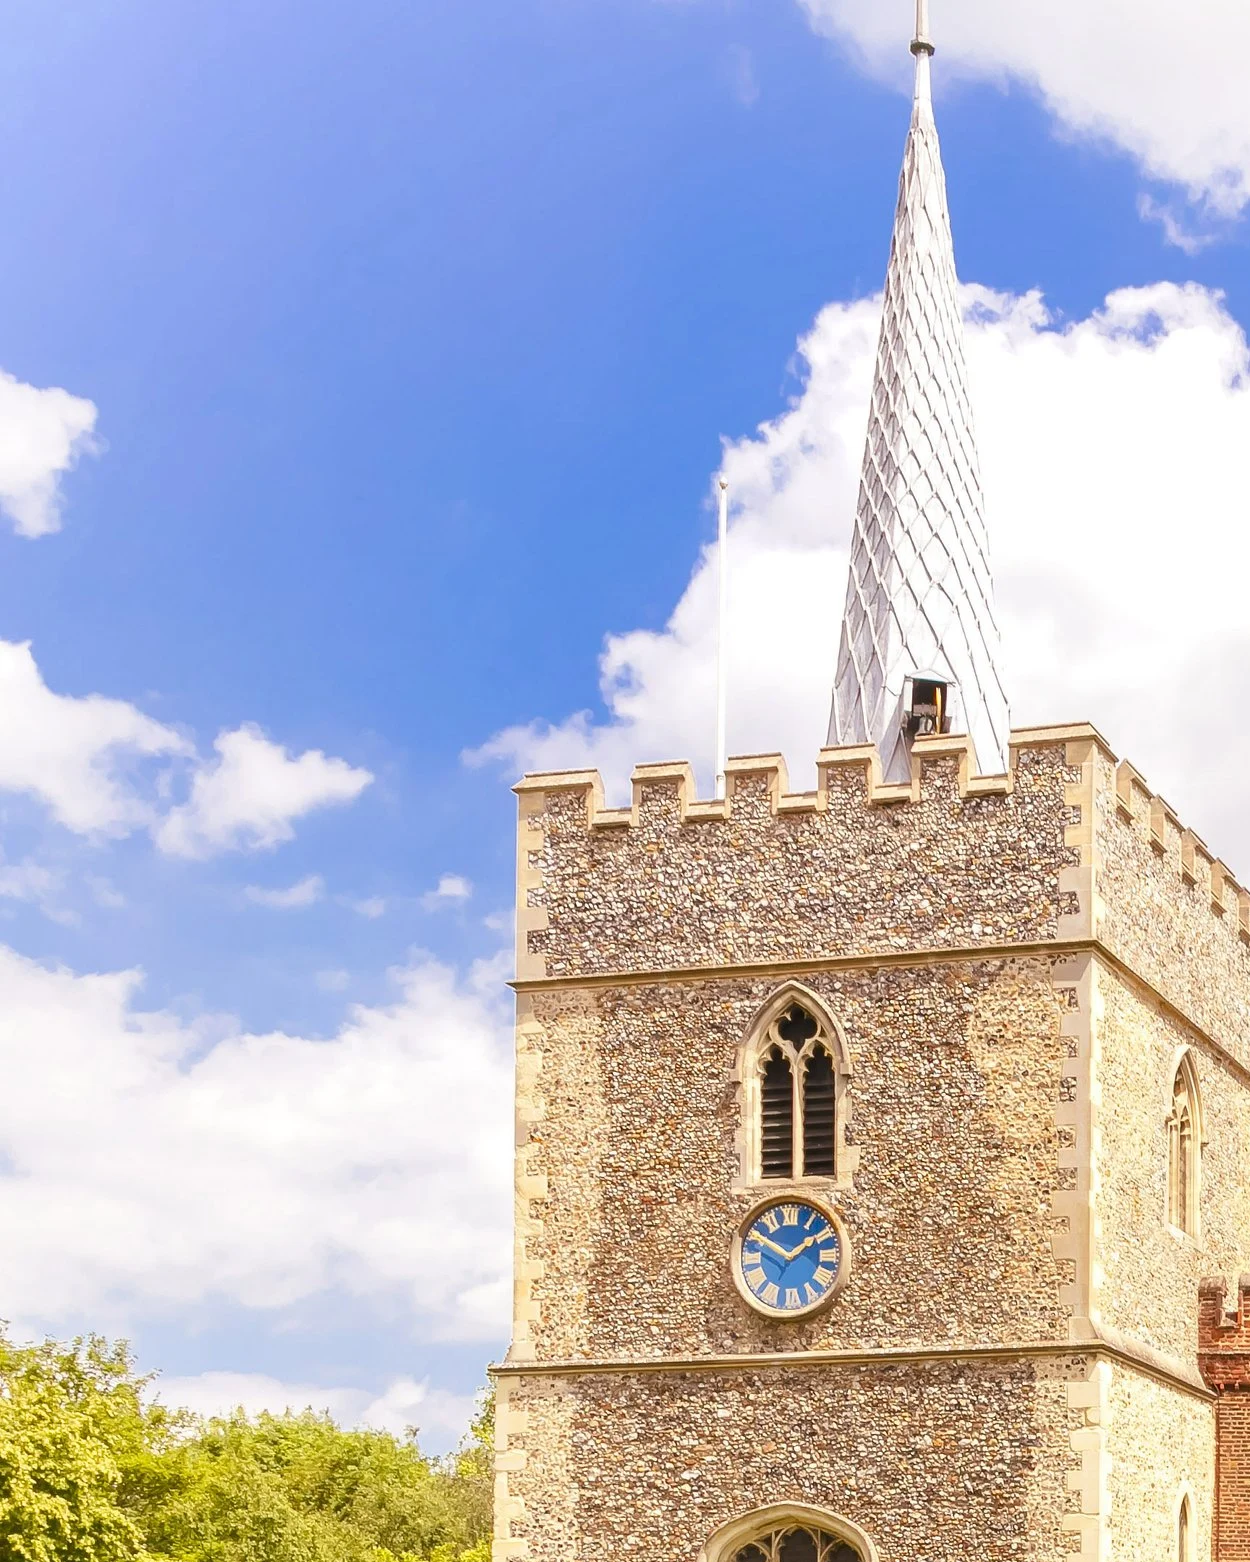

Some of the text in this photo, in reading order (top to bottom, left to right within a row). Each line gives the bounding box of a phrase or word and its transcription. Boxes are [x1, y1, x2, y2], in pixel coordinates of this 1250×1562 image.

[781, 1207, 800, 1226] XII
[803, 1211, 817, 1231] I
[814, 1226, 833, 1244] II
[819, 1248, 837, 1263] III
